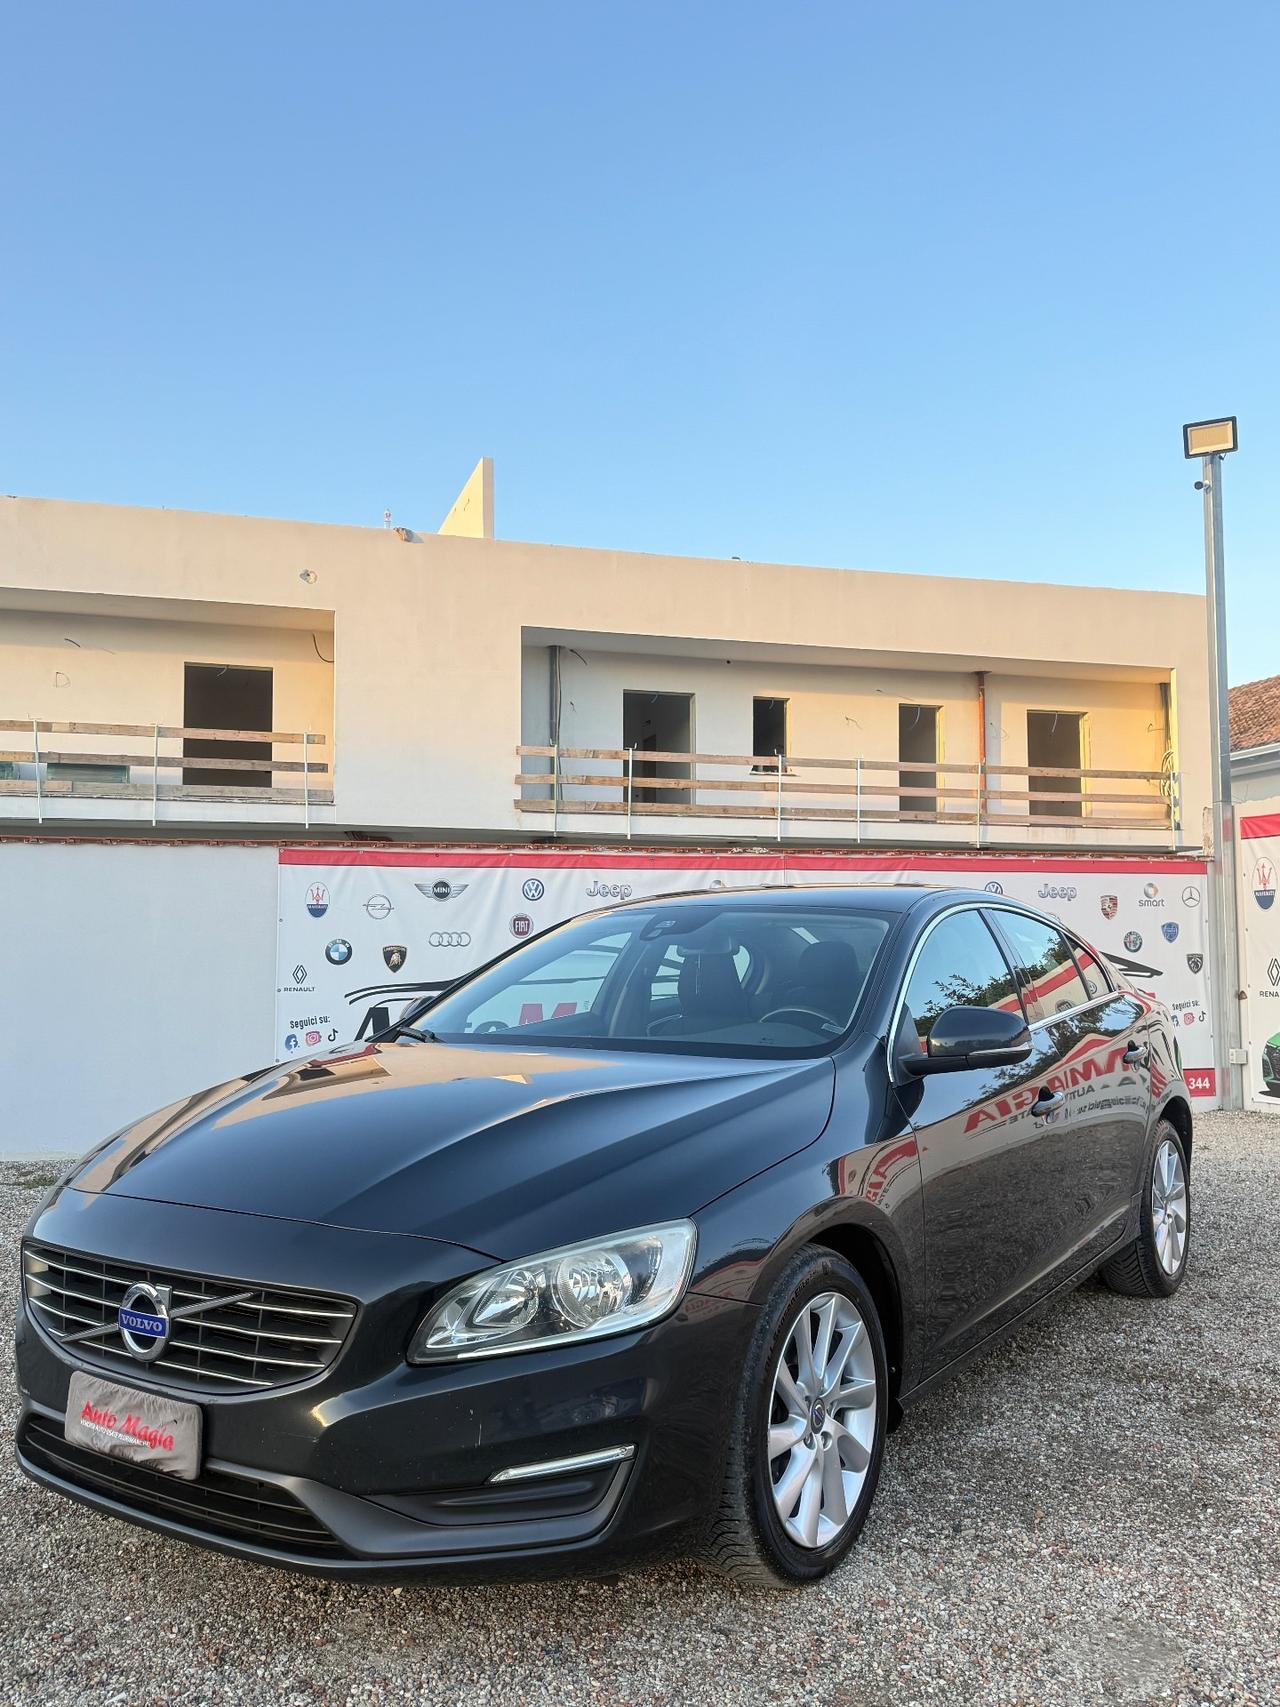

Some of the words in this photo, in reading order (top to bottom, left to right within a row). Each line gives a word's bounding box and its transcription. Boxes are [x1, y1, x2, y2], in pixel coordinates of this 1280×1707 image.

[433, 886, 450, 894] MINI
[585, 880, 633, 901] Jeep
[1038, 883, 1077, 902] Jeep
[1138, 899, 1165, 907] smart
[514, 920, 529, 932] FIAT
[1188, 1077, 1210, 1089] 344
[121, 1313, 163, 1332] VOLVO
[81, 1401, 117, 1429] Auto
[119, 1411, 174, 1451] Magia
